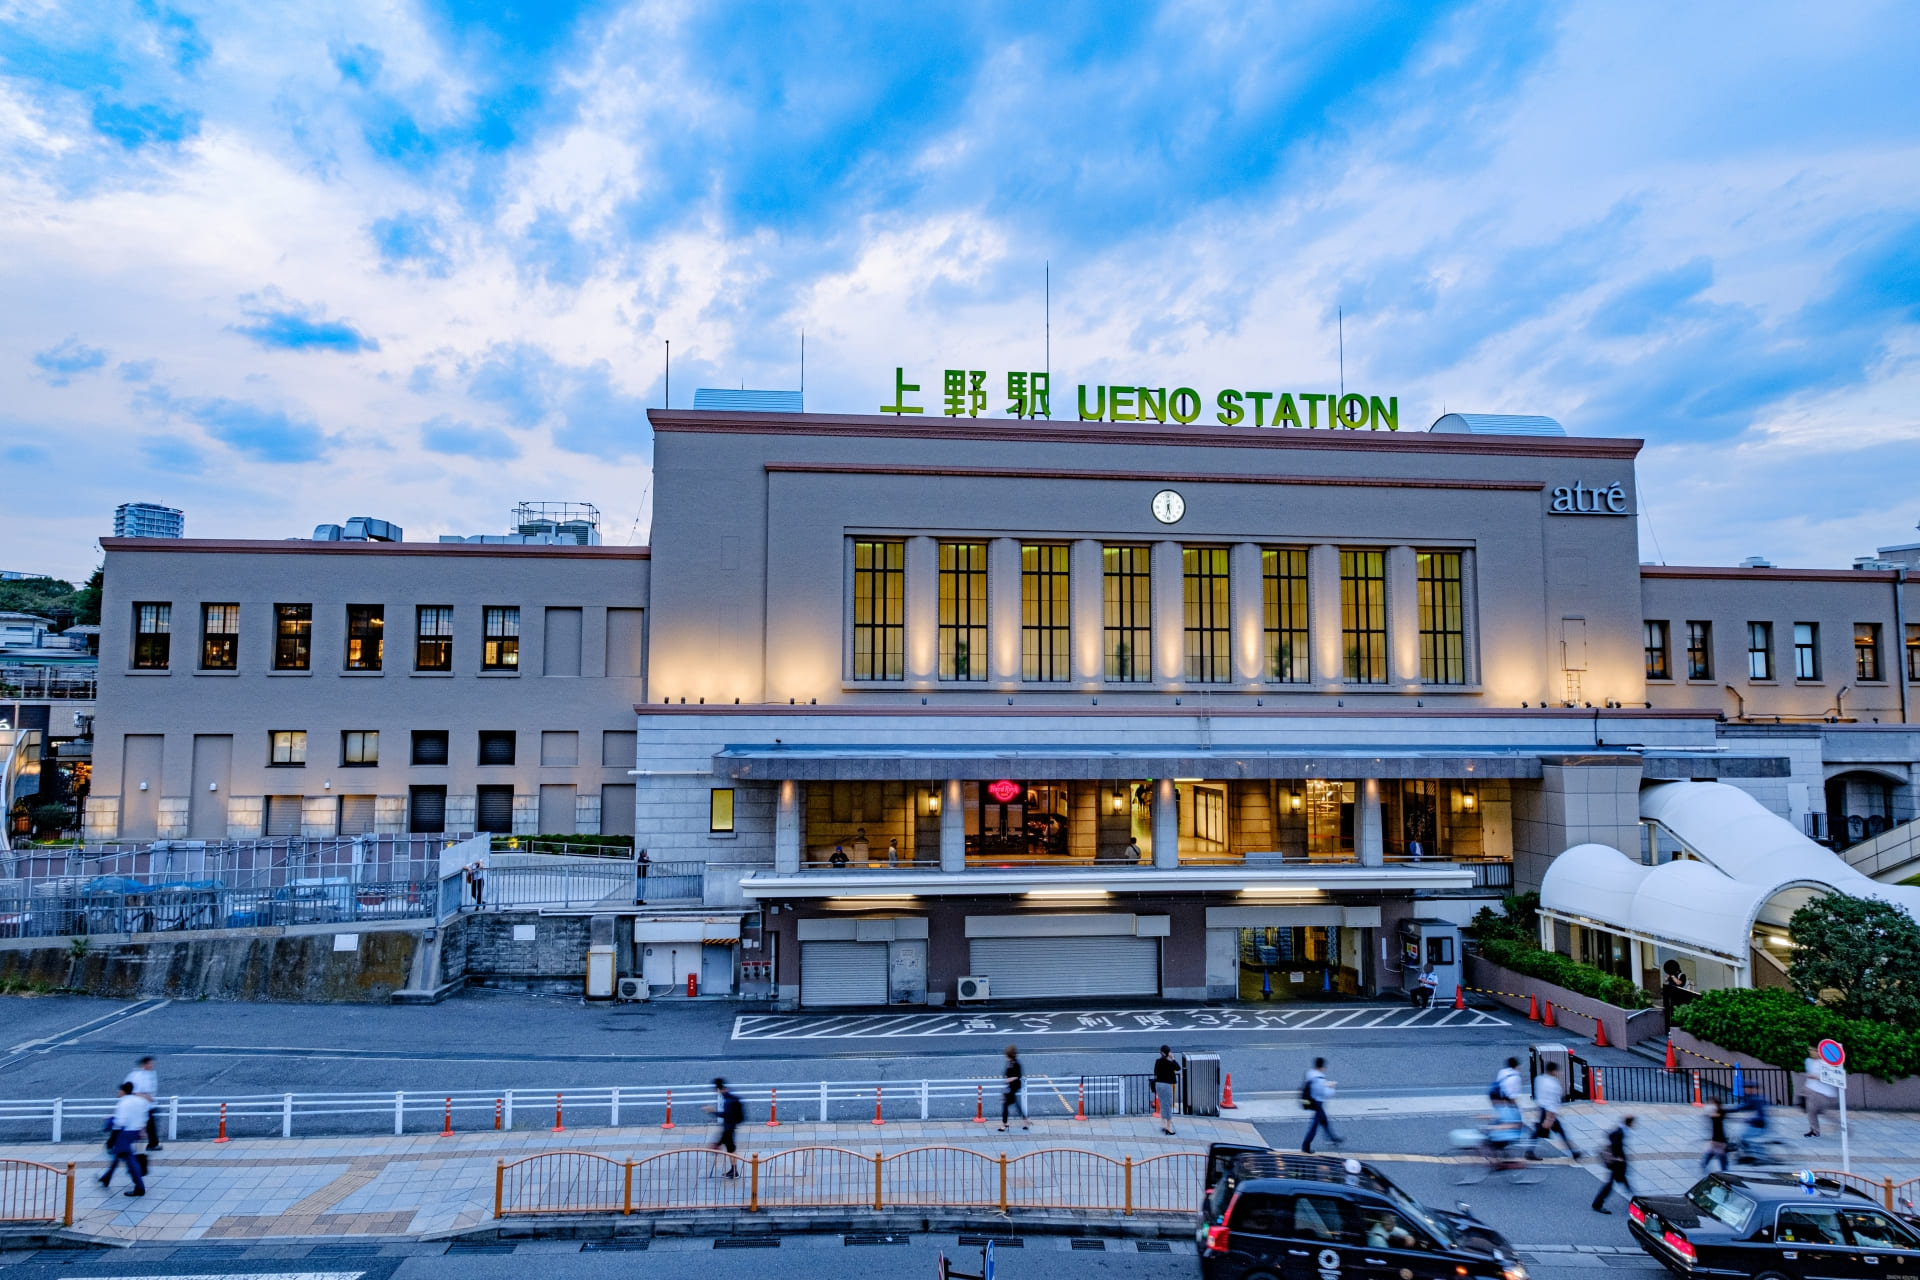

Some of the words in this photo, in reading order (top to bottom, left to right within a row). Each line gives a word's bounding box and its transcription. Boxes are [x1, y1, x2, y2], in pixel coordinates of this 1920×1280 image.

[879, 367, 1051, 418] 上野駅
[1077, 384, 1201, 424] UENO
[1216, 389, 1398, 431] STATION
[1553, 480, 1627, 512] atré
